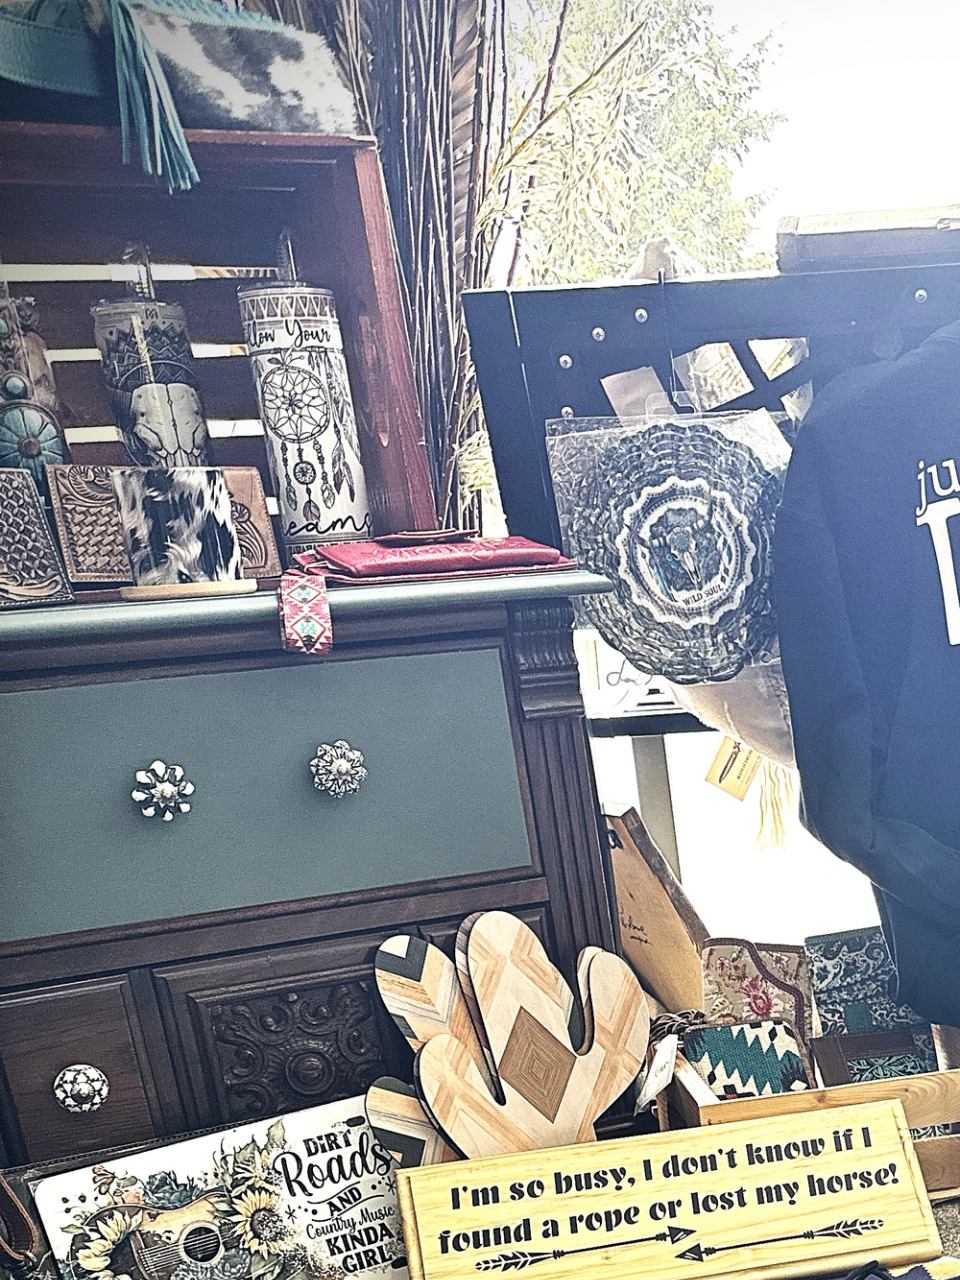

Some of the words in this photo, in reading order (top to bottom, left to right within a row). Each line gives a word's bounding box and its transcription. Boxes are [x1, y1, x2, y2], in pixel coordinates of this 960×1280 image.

[285, 319, 330, 348] Your
[682, 592, 703, 606] WILD
[704, 584, 723, 598] SOUL
[272, 1132, 393, 1198] Roads
[450, 1184, 500, 1210] I'm
[509, 1179, 545, 1201] so
[553, 1164, 636, 1195] busy,
[643, 1159, 653, 1182] I
[661, 1147, 737, 1179] don't
[745, 1135, 825, 1166] know
[833, 1127, 860, 1152] if
[863, 1126, 872, 1149] I
[328, 1186, 362, 1218] AND
[438, 1217, 533, 1255] found
[541, 1217, 560, 1239] a
[568, 1205, 641, 1236] rope
[648, 1197, 683, 1220] or
[690, 1184, 748, 1215] lost
[756, 1178, 800, 1206] my
[807, 1162, 900, 1197] horse!
[306, 1214, 357, 1240] Country
[358, 1205, 396, 1227] Music
[325, 1222, 395, 1257] KINDA
[341, 1244, 393, 1275] GIRL
